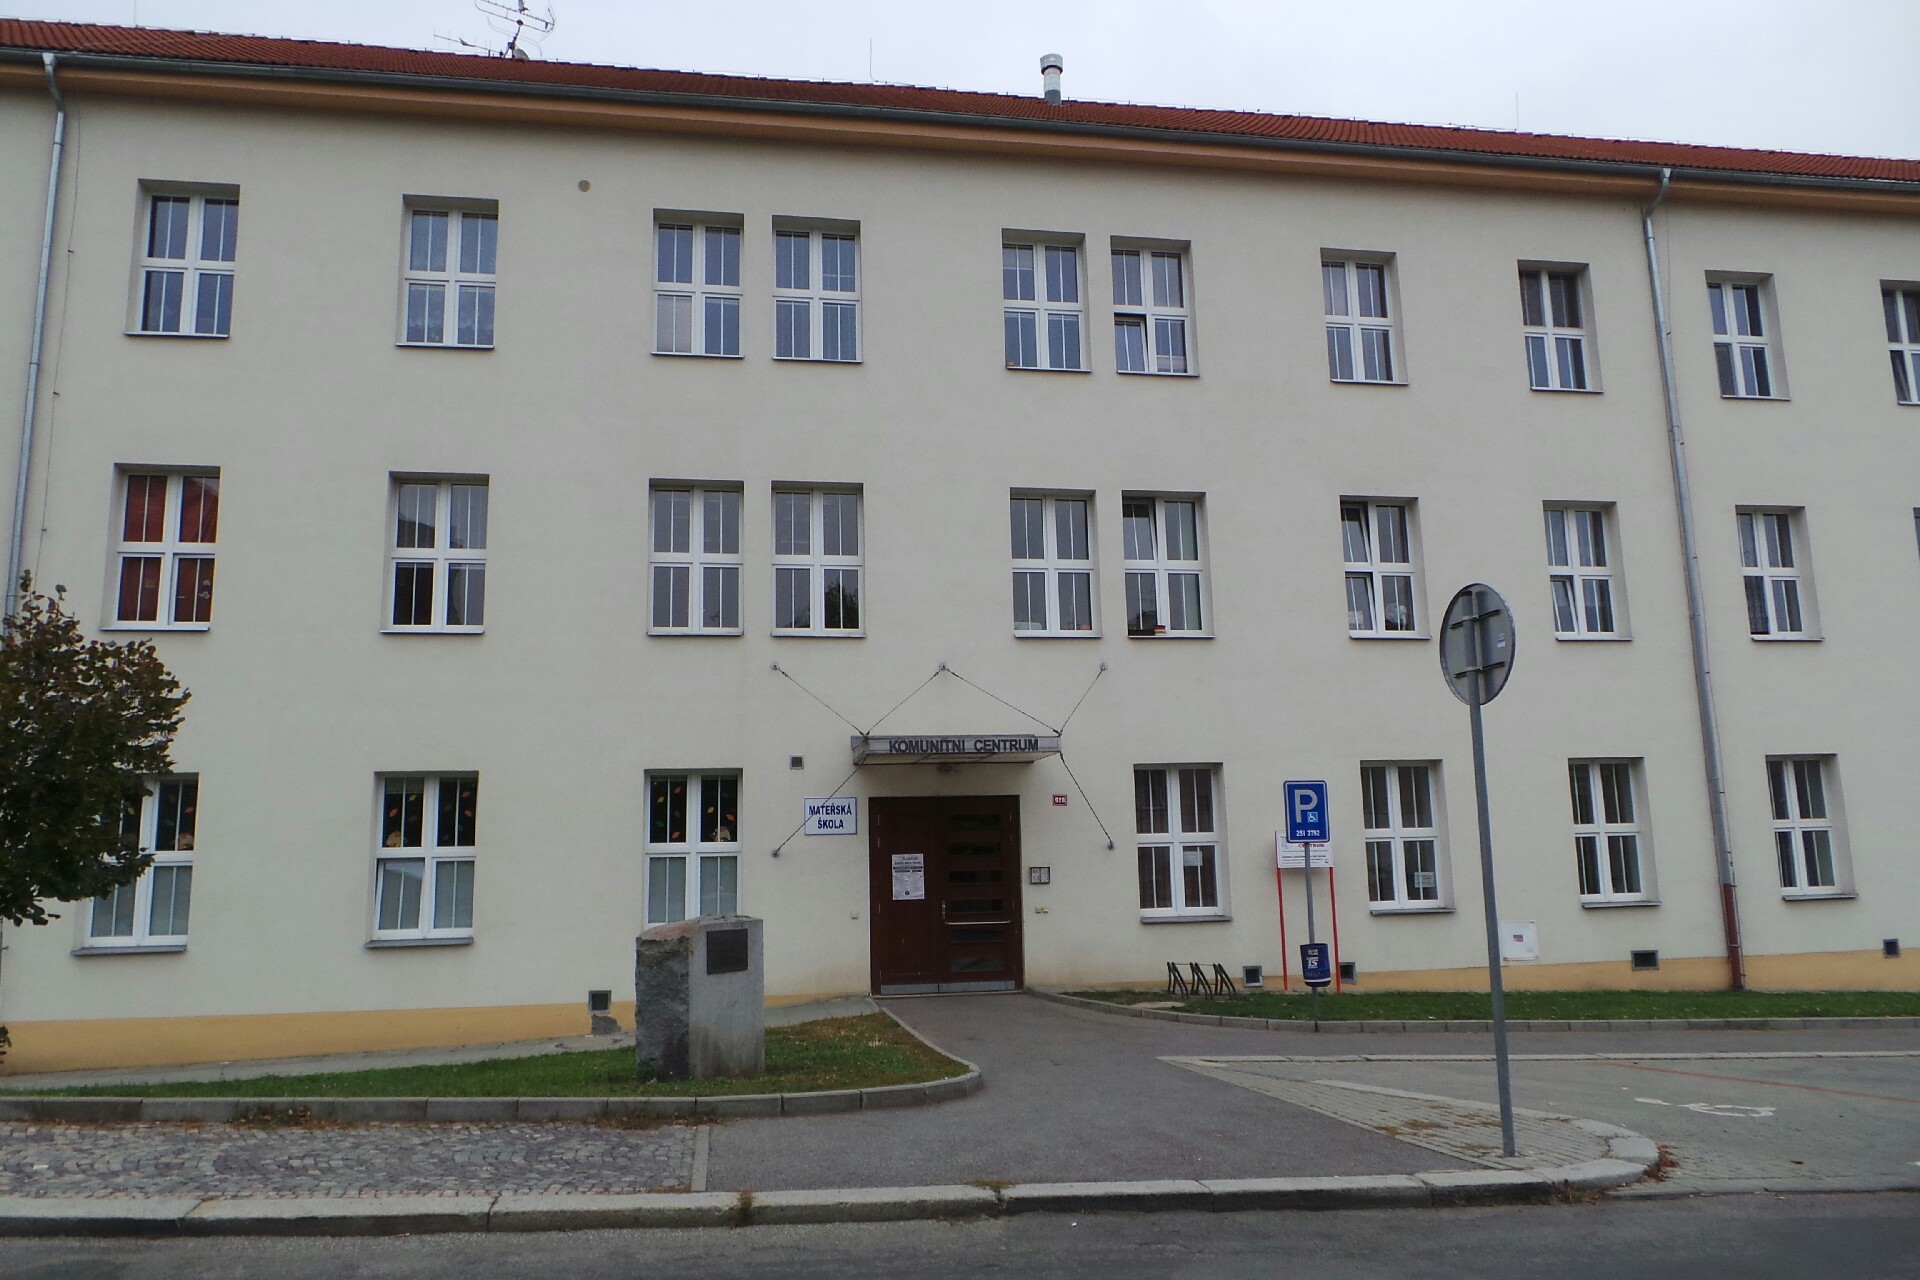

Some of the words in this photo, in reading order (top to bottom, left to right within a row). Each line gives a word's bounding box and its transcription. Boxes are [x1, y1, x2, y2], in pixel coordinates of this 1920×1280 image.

[974, 738, 1039, 752] CENTRUM
[808, 803, 852, 816] MATEŘSKÁ
[1294, 789, 1318, 823] P
[817, 817, 844, 830] ŠKOLA
